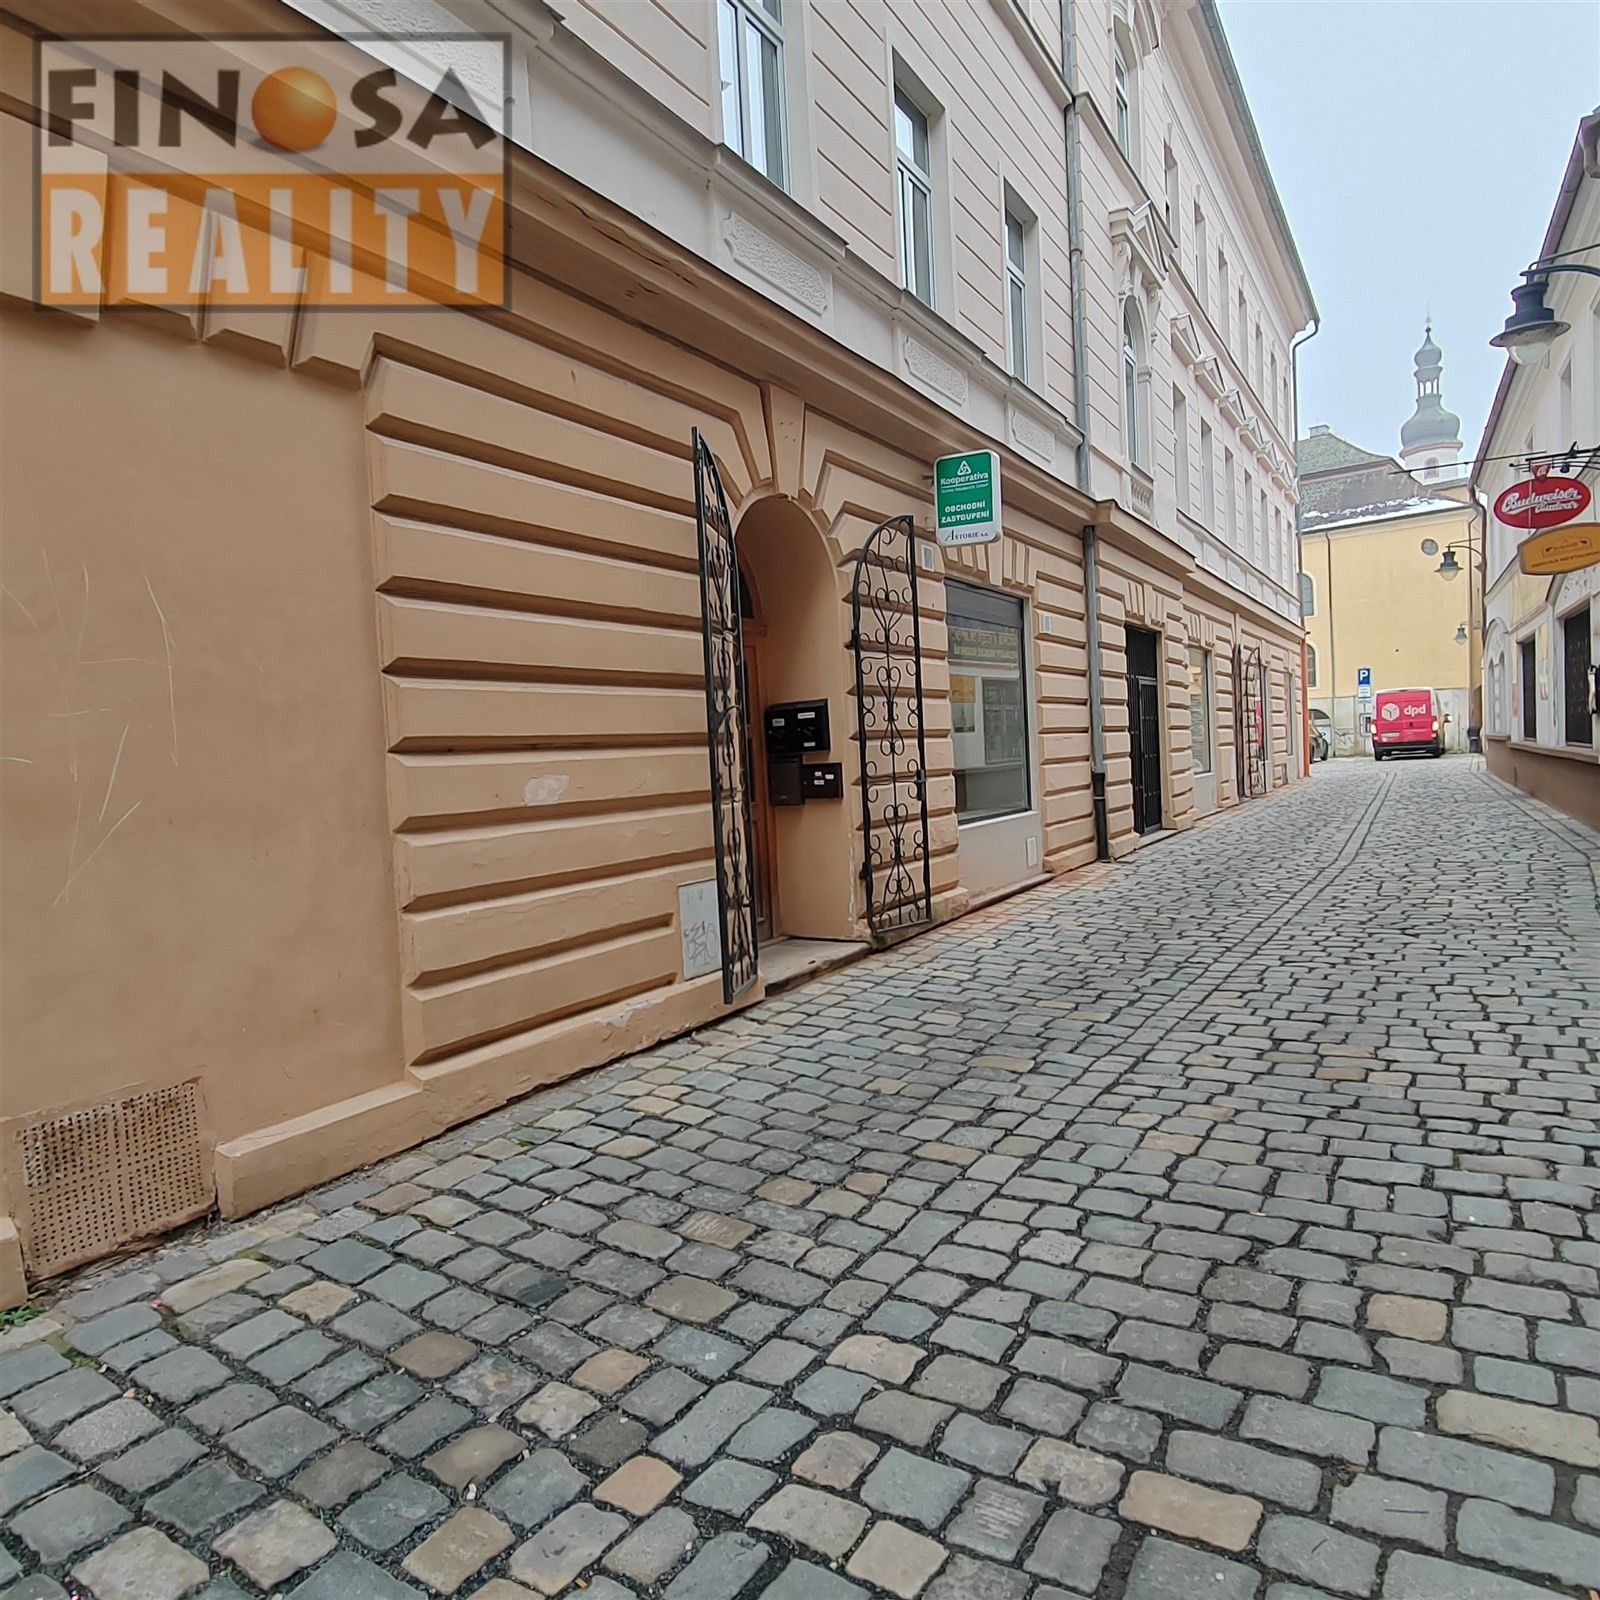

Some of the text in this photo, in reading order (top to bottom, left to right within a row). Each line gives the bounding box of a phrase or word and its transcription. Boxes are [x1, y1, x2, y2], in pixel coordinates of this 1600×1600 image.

[940, 472, 989, 484] Kooperativa
[945, 500, 986, 513] OBCHODNÍ
[1502, 488, 1582, 514] Budweiser
[941, 509, 990, 524] ZASTOUPENÍ
[1360, 670, 1368, 681] P
[1404, 704, 1426, 717] dpd
